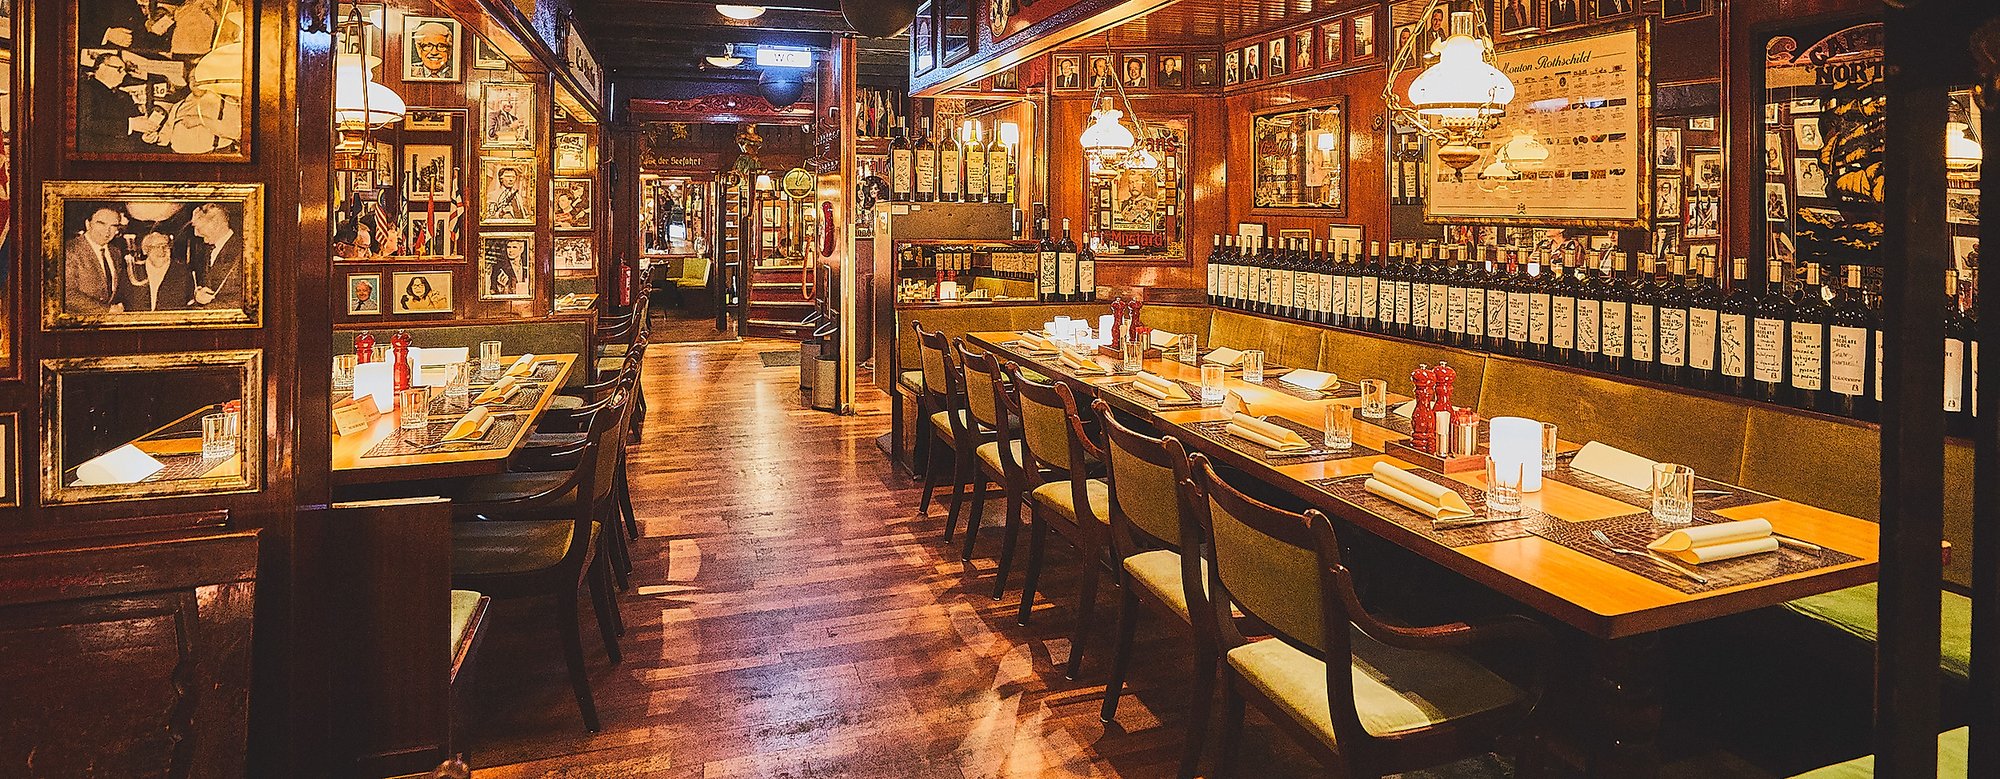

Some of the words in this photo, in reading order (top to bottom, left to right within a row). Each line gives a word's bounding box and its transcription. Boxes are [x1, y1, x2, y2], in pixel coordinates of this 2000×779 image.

[774, 53, 794, 63] WC
[1535, 51, 1592, 70] Rothschild
[1112, 231, 1163, 247] Mustard
